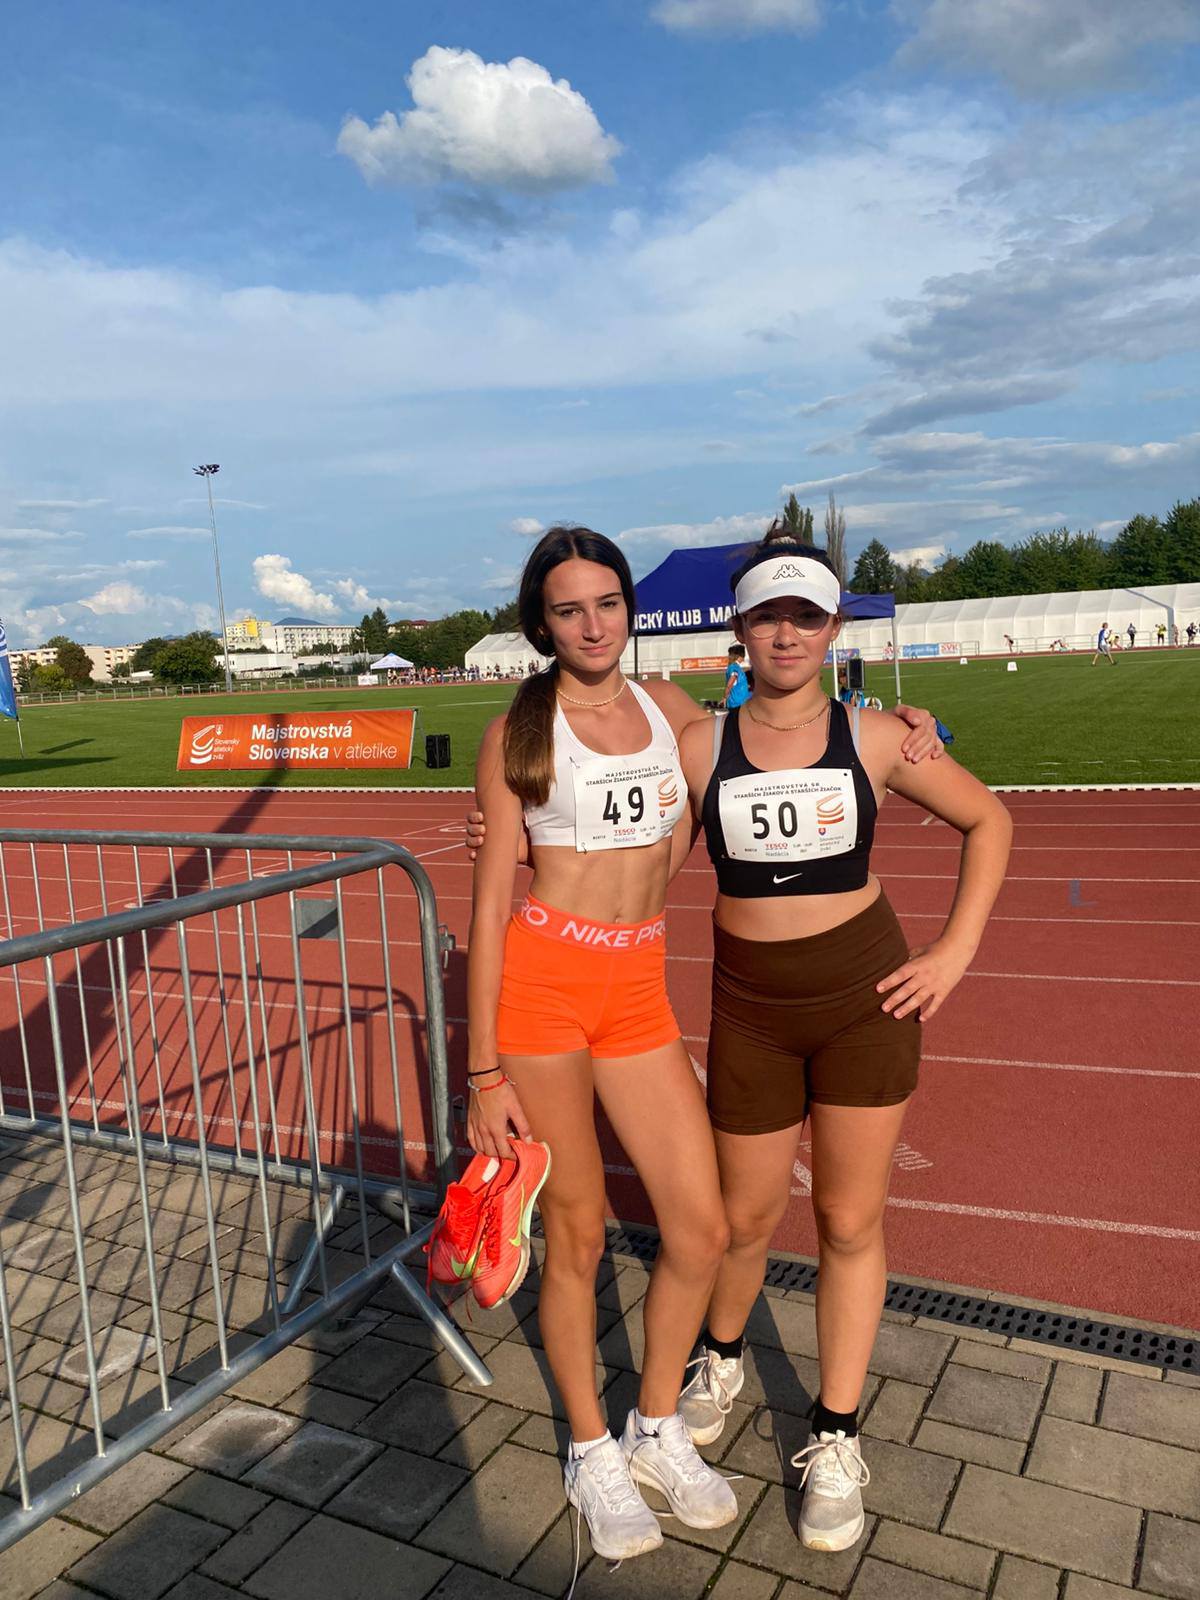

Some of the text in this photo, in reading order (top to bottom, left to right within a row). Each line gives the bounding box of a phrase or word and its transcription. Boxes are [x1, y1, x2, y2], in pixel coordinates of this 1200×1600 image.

[633, 609, 663, 630] ICKÝ
[666, 608, 701, 627] KLUB
[251, 719, 353, 743] Majstrovstvá
[248, 743, 397, 761] Slovenska v atletike
[602, 786, 645, 825] 49
[614, 827, 636, 836] TESCO
[751, 801, 798, 839] 50
[560, 920, 635, 948] NIKE
[635, 919, 666, 945] PR
